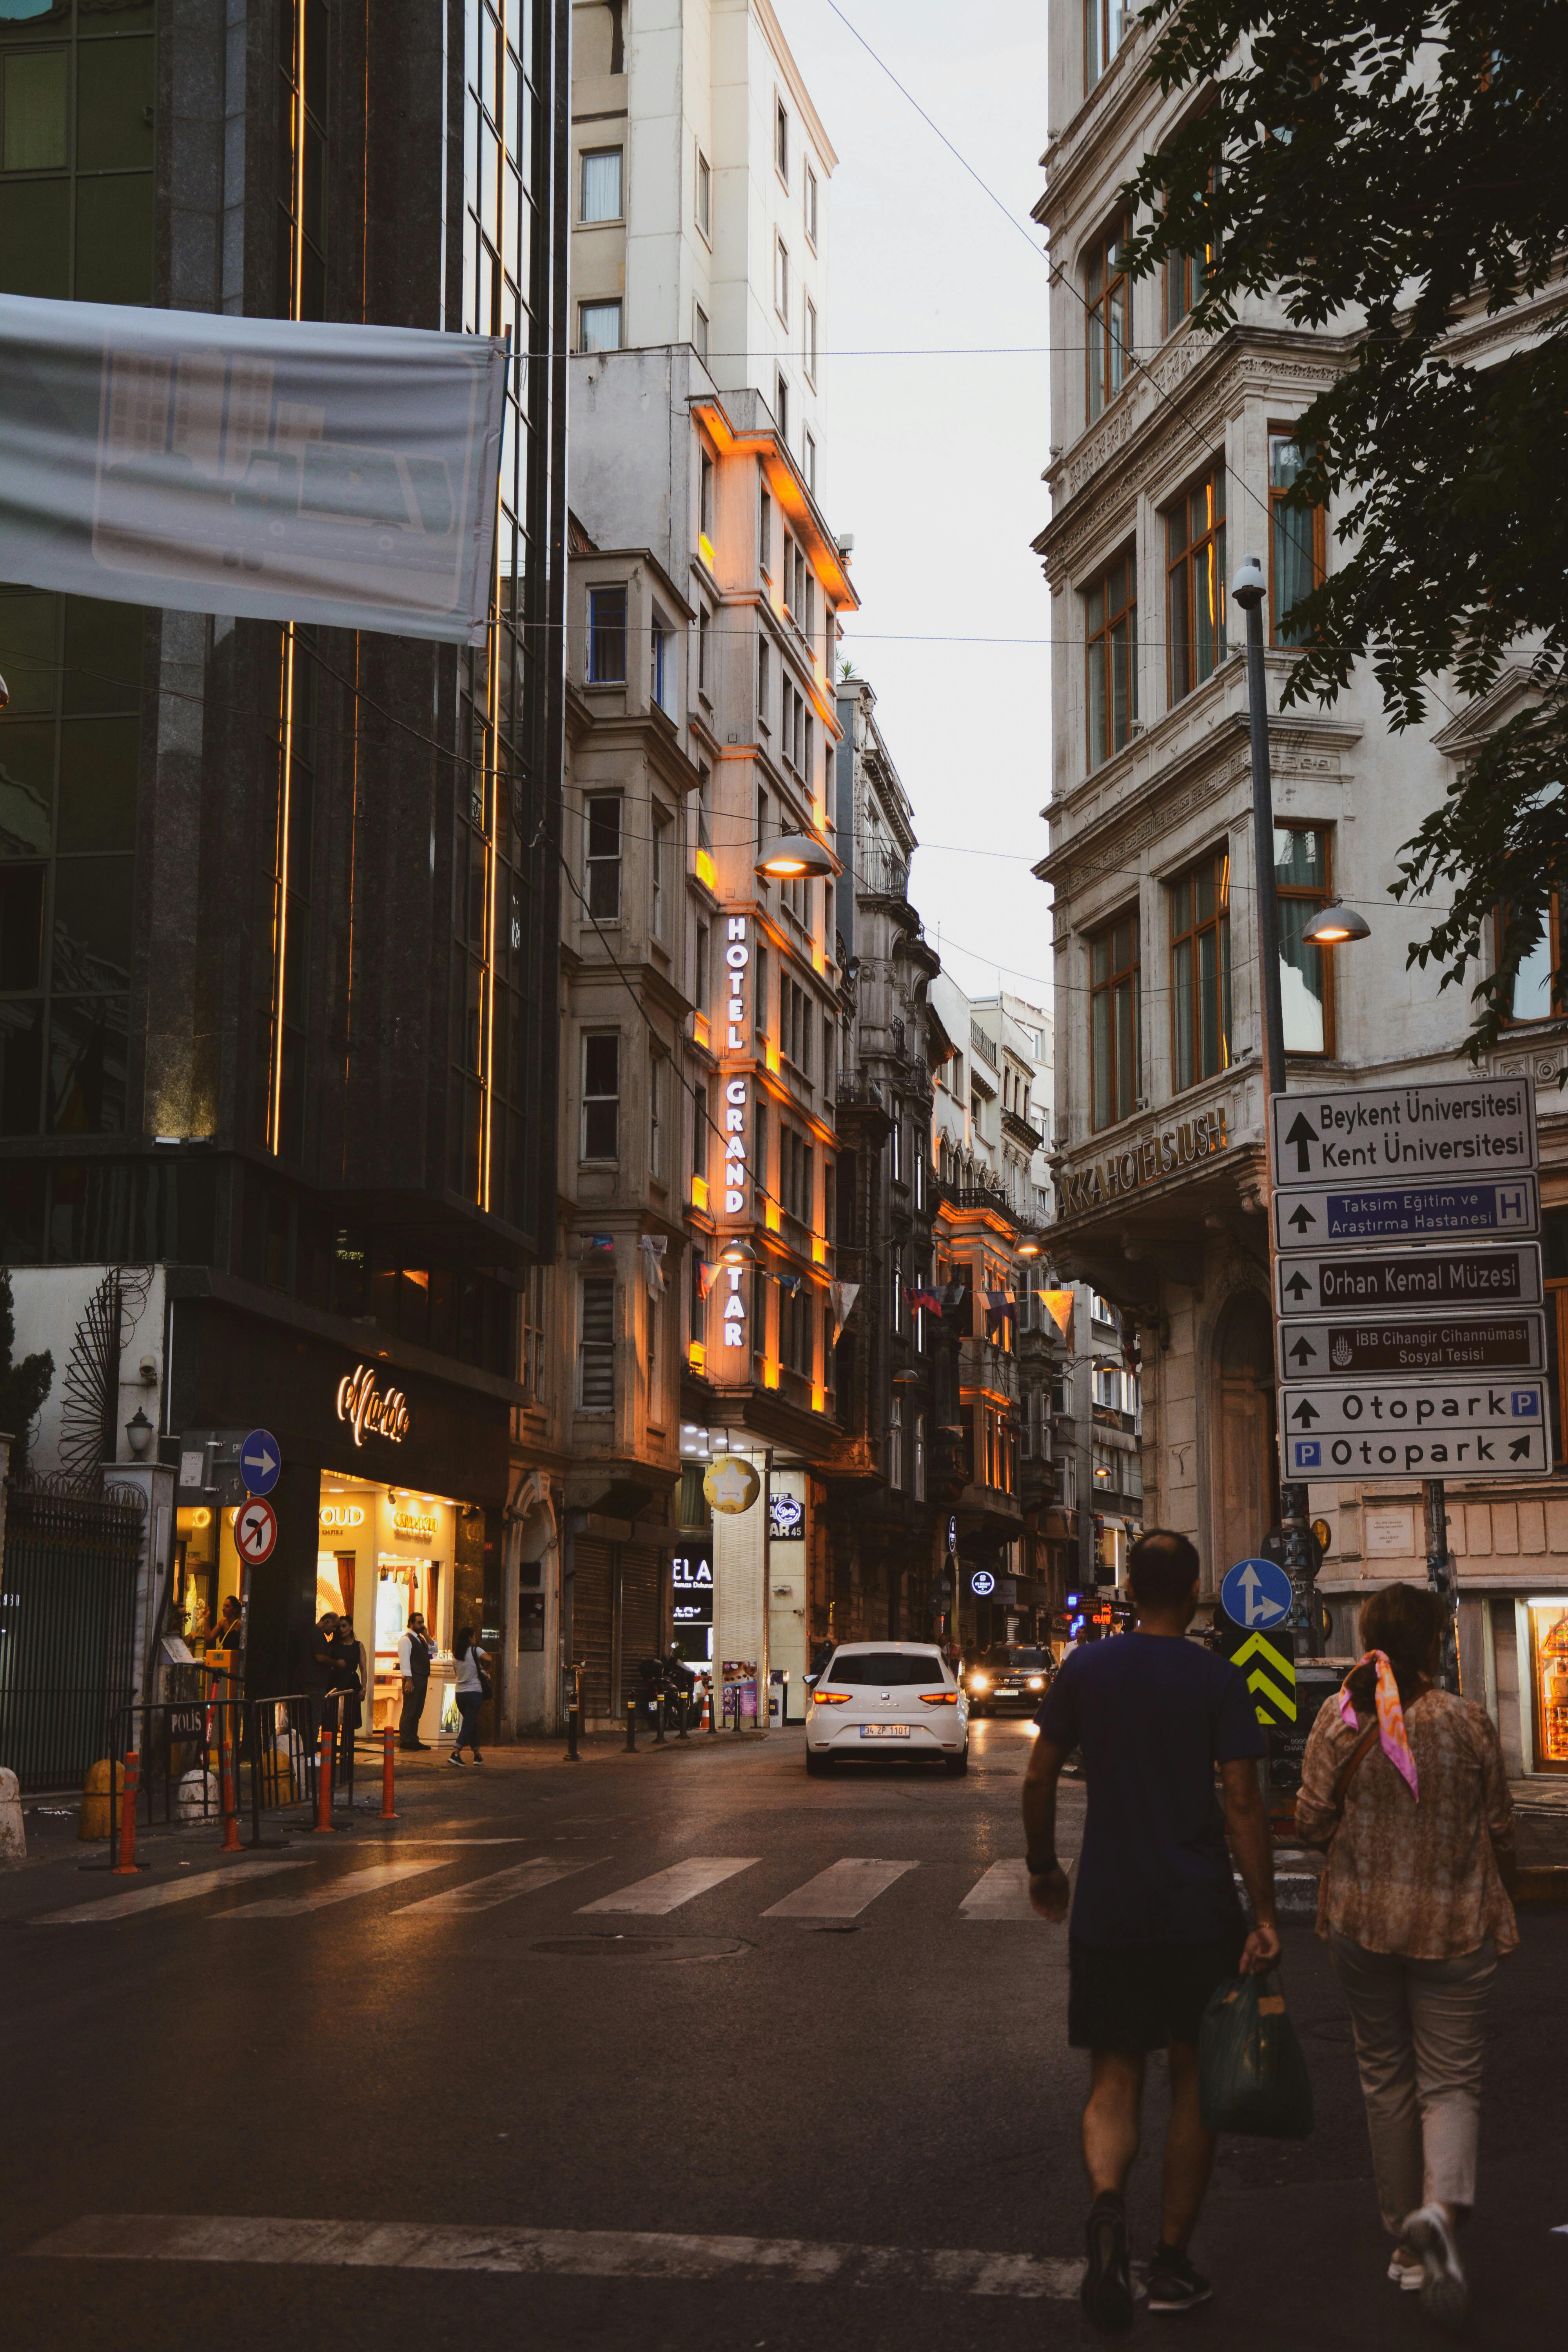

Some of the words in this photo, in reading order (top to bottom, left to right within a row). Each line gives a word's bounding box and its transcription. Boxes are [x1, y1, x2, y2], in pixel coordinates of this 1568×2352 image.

[726, 918, 749, 1049] HOTEL
[1321, 1101, 1401, 1134] Beykent
[1406, 1091, 1522, 1124] Üniversitesi
[725, 1081, 746, 1213] GRAND
[1322, 1143, 1377, 1168] Kent
[1384, 1131, 1524, 1163] Üniversitesi
[1058, 1165, 1109, 1216] AKKA
[1107, 1132, 1176, 1196] HOTELS
[1342, 1198, 1397, 1213] Taksim
[1404, 1195, 1455, 1210] Eğitim
[1461, 1195, 1478, 1205] ve
[1500, 1192, 1522, 1219] H
[1332, 1217, 1408, 1234] Araştırma
[1415, 1212, 1492, 1228] Hastanesi
[724, 1240, 745, 1346] TAR
[1323, 1270, 1377, 1295] Orhan
[1385, 1265, 1442, 1292] Kemal
[1450, 1263, 1516, 1288] Müzesi
[1356, 1330, 1378, 1346] İBB
[1383, 1328, 1437, 1346] Cihangir
[1441, 1328, 1527, 1342] Cihannüması
[1399, 1349, 1442, 1365] Sosyal
[1446, 1347, 1485, 1361] Tesisi
[1342, 1390, 1507, 1425] Otopark
[1517, 1394, 1532, 1413] P
[1301, 1445, 1314, 1464] P
[1332, 1436, 1495, 1470] Otopark
[320, 1508, 362, 1525] OUD
[791, 1527, 801, 1536] 45
[171, 1709, 201, 1733] POLİS
[877, 1726, 886, 1735] ZP
[890, 1726, 907, 1735] 1101
